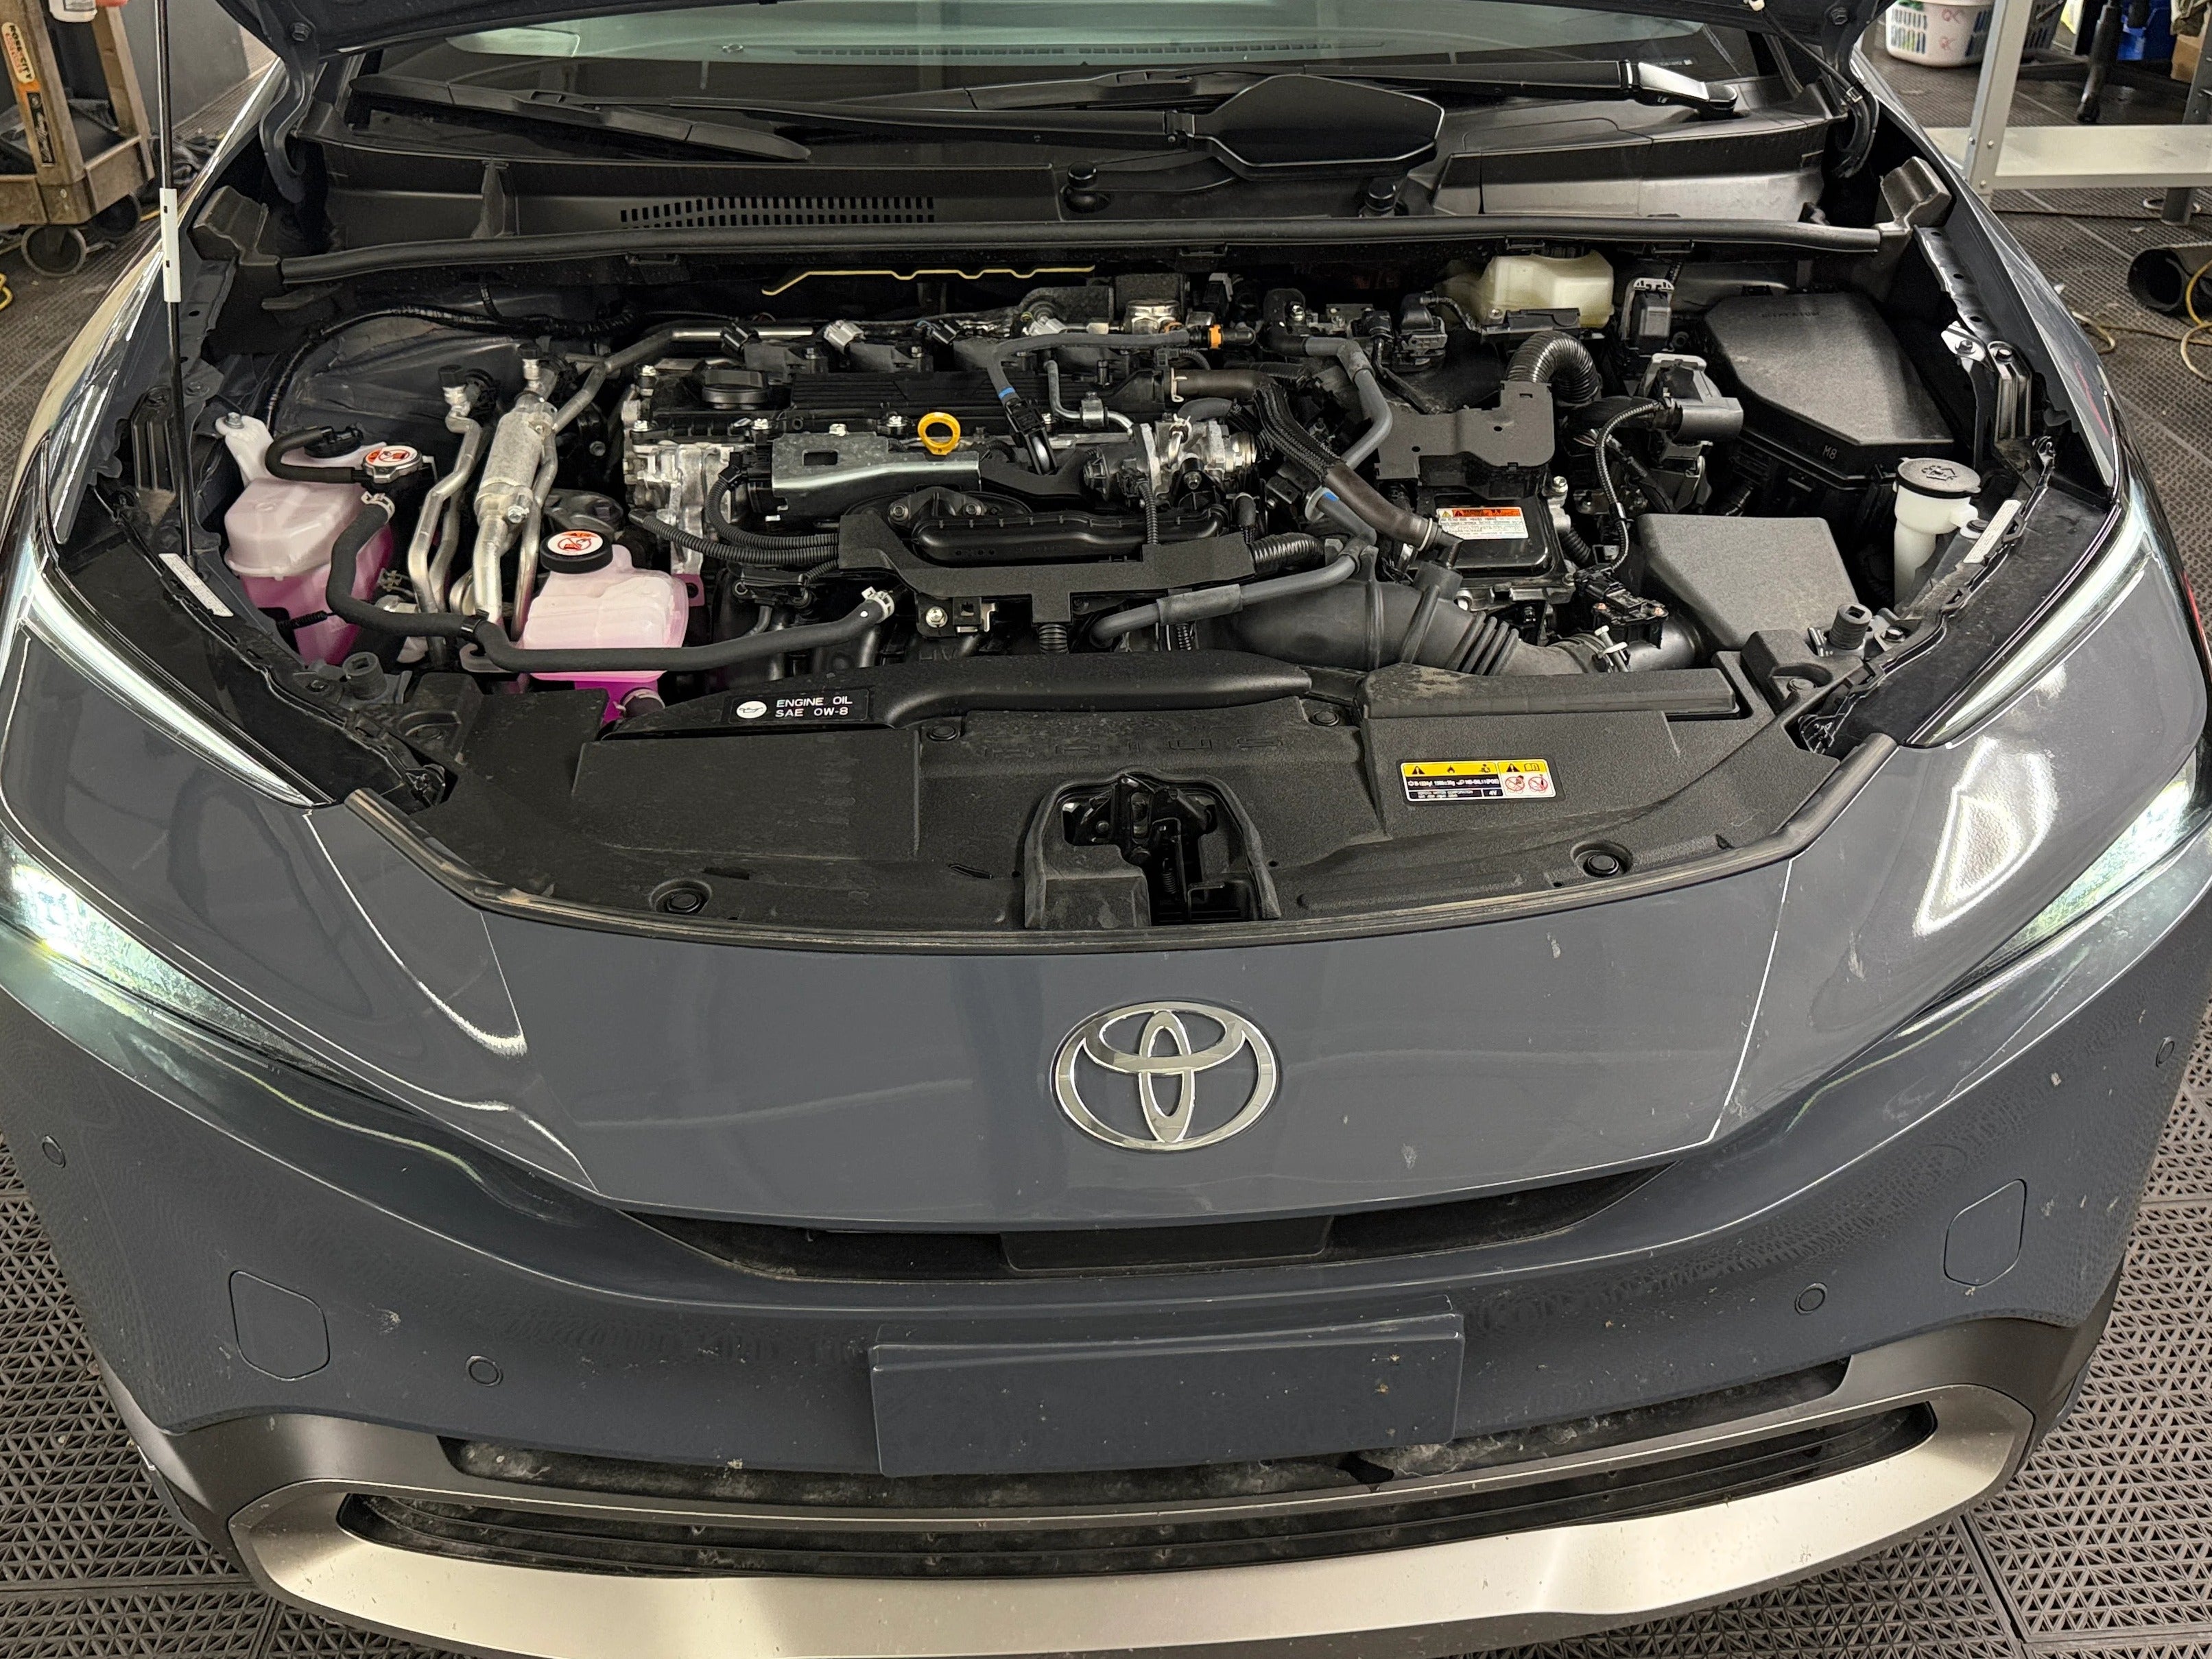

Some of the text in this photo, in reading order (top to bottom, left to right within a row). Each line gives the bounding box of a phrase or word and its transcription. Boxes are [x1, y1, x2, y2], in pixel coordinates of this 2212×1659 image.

[1822, 445, 1838, 459] M8
[776, 695, 853, 708] ENGINE OIL
[775, 708, 805, 718] SAE
